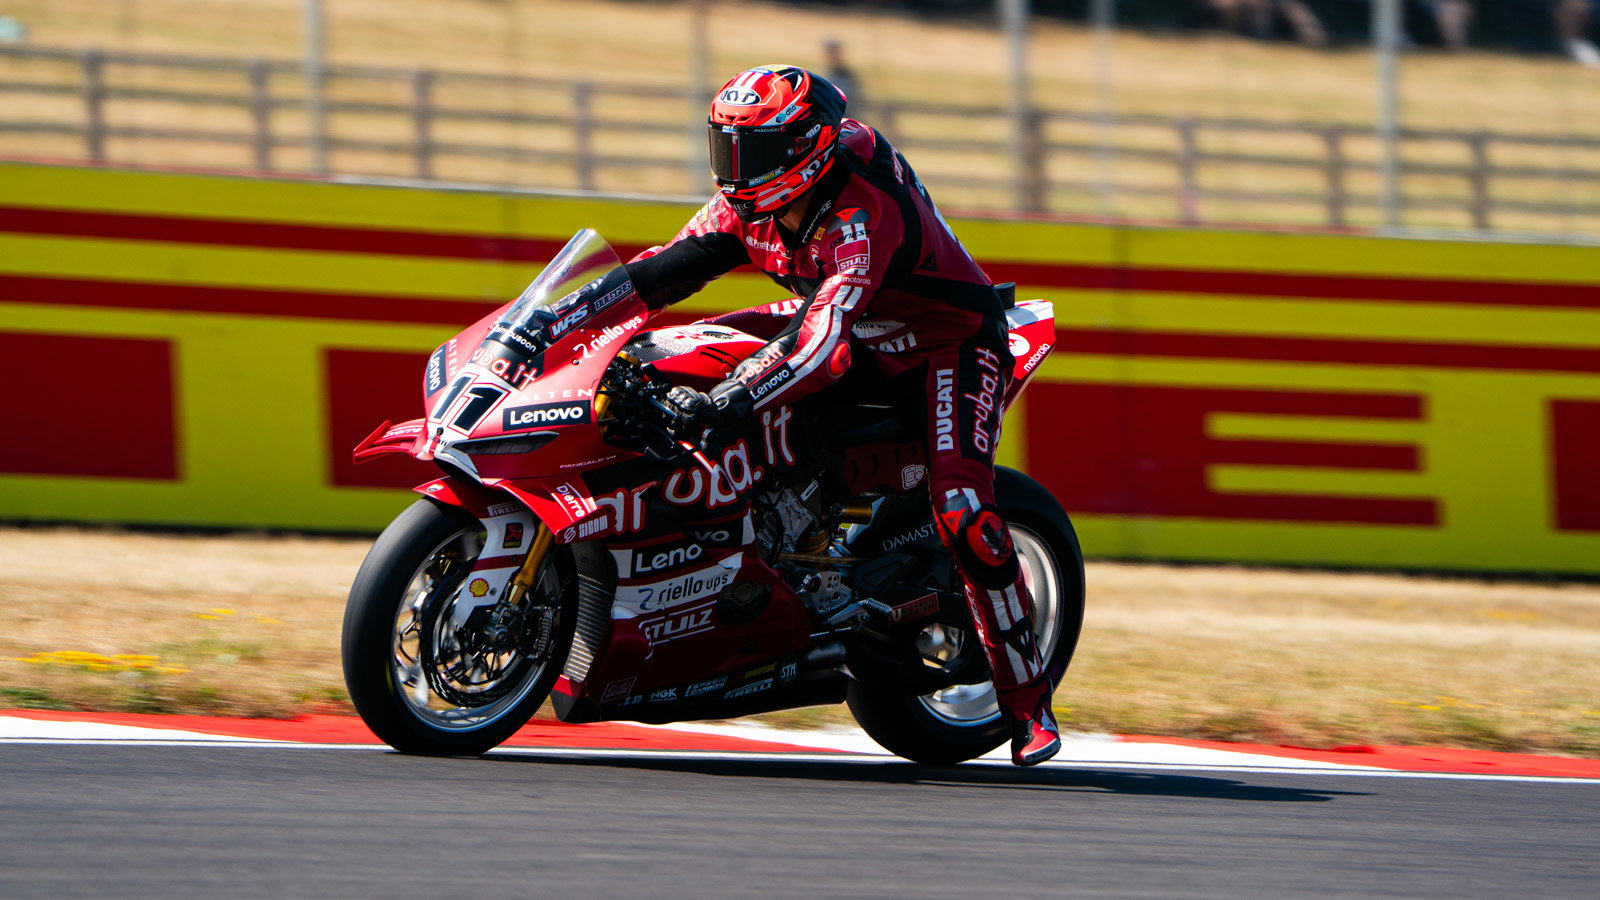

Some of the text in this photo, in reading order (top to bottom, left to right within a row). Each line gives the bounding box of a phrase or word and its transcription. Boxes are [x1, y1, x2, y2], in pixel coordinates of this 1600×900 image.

[719, 90, 757, 103] KYT
[840, 256, 868, 270] STULZ
[842, 276, 871, 285] motorola
[551, 304, 589, 337] WRS
[590, 315, 643, 352] riello ups
[429, 348, 443, 391] Lenovo
[472, 342, 541, 392] uba.it
[1023, 343, 1051, 373] motorola
[750, 369, 790, 401] Lenovo
[510, 406, 583, 425] Lenovo
[936, 368, 954, 451] DUCATI
[964, 346, 1000, 455] aruba.it
[556, 485, 585, 517] Dierre
[883, 524, 935, 551] DAMAST
[658, 574, 729, 602] riello ups
[781, 663, 797, 679] STM
[650, 688, 677, 699] NGK
